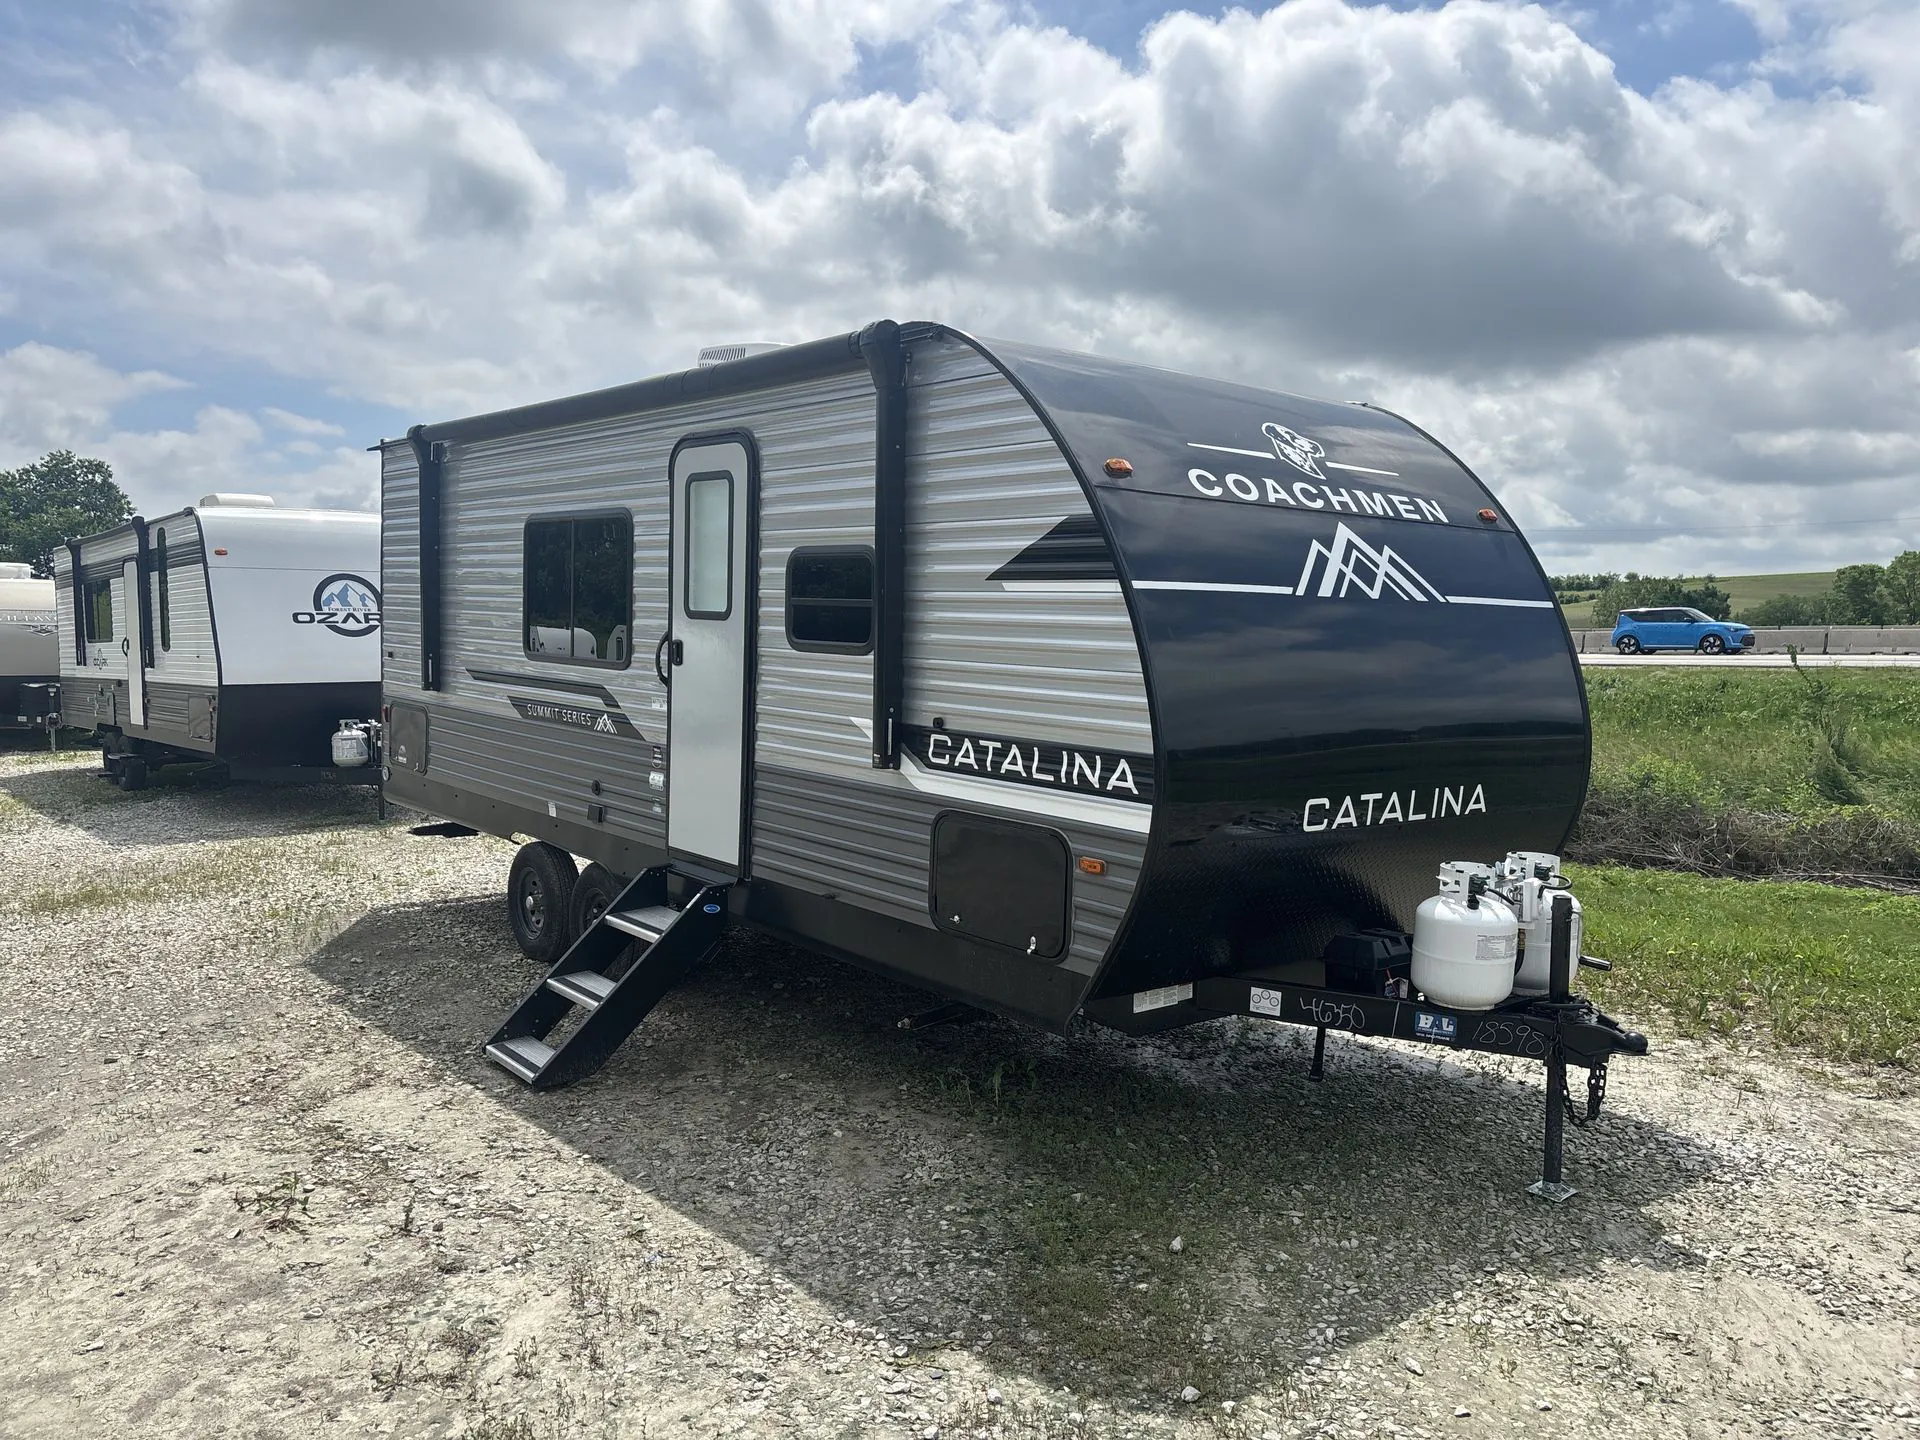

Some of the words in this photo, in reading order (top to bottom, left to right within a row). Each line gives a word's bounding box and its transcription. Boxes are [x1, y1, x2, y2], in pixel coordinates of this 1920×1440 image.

[1187, 468, 1449, 523] COACHMEN
[292, 612, 381, 624] OZAR
[527, 704, 559, 719] SUMMIT
[561, 709, 591, 726] SERIES
[928, 734, 1139, 795] CATALINA
[1303, 784, 1486, 832] CATALINA
[1300, 997, 1365, 1029] 46350
[1472, 1021, 1545, 1055] 18598
